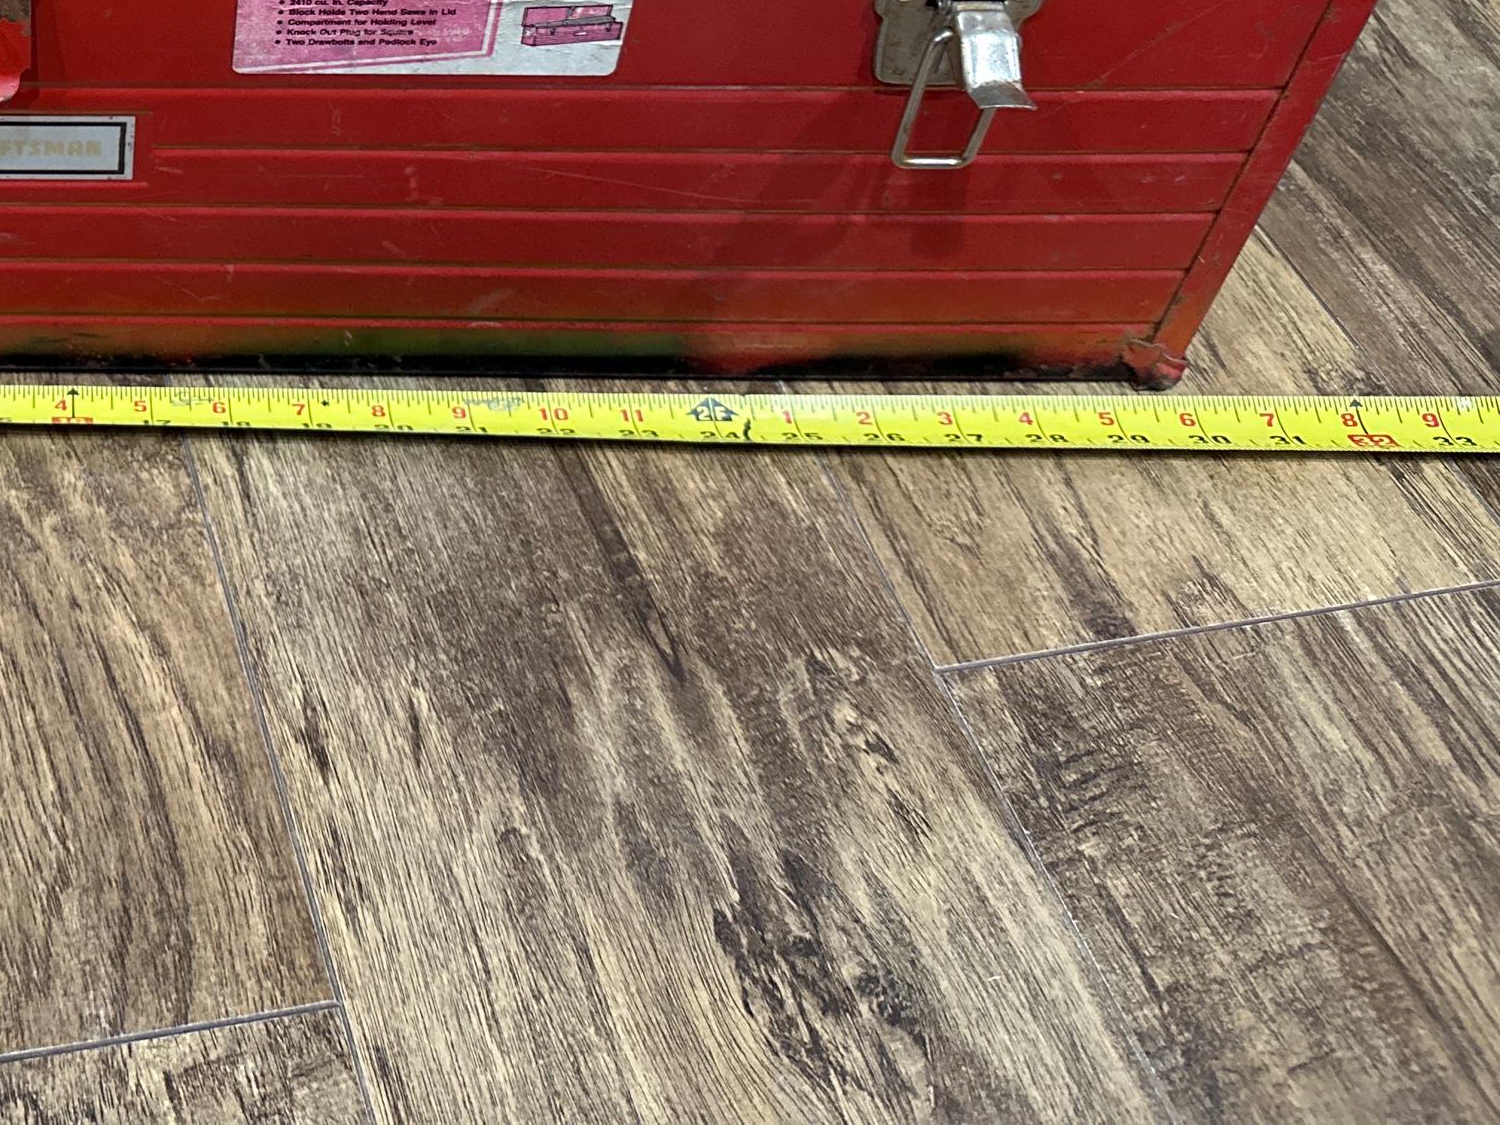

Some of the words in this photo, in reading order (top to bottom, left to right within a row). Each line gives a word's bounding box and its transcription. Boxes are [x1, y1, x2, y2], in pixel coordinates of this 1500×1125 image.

[347, 0, 388, 7] Capacity
[287, 19, 351, 27] Compartment
[370, 19, 407, 27] Holding
[286, 28, 317, 36] Knock
[319, 28, 336, 36] Out
[339, 28, 361, 37] Plug
[364, 28, 377, 36] for
[308, 38, 355, 46] Drawbolts
[357, 38, 376, 46] and
[378, 38, 417, 46] Padlock
[419, 38, 438, 47] Eye
[54, 399, 68, 412] 4
[133, 401, 148, 413] 5
[212, 402, 227, 414] 6
[292, 403, 306, 416] 7
[371, 405, 386, 418] 8
[452, 406, 467, 419] 9
[539, 408, 569, 421] 10
[618, 409, 644, 423] 11
[782, 411, 793, 424] 1
[856, 411, 873, 425] 2
[937, 412, 953, 426] 3
[1018, 412, 1034, 426] 4
[1098, 412, 1115, 426] 5
[1179, 412, 1196, 427] 6
[1259, 413, 1275, 427] 7
[1341, 413, 1358, 427] 8
[1421, 413, 1440, 428] 9
[781, 432, 823, 441] 25
[864, 433, 905, 442] 26
[943, 434, 984, 443] 27
[1026, 434, 1069, 443] 28
[1107, 434, 1150, 444] 29
[1188, 435, 1232, 444] 30
[1269, 435, 1307, 445] 31
[1355, 436, 1394, 446] 32
[1432, 437, 1477, 447] 33
